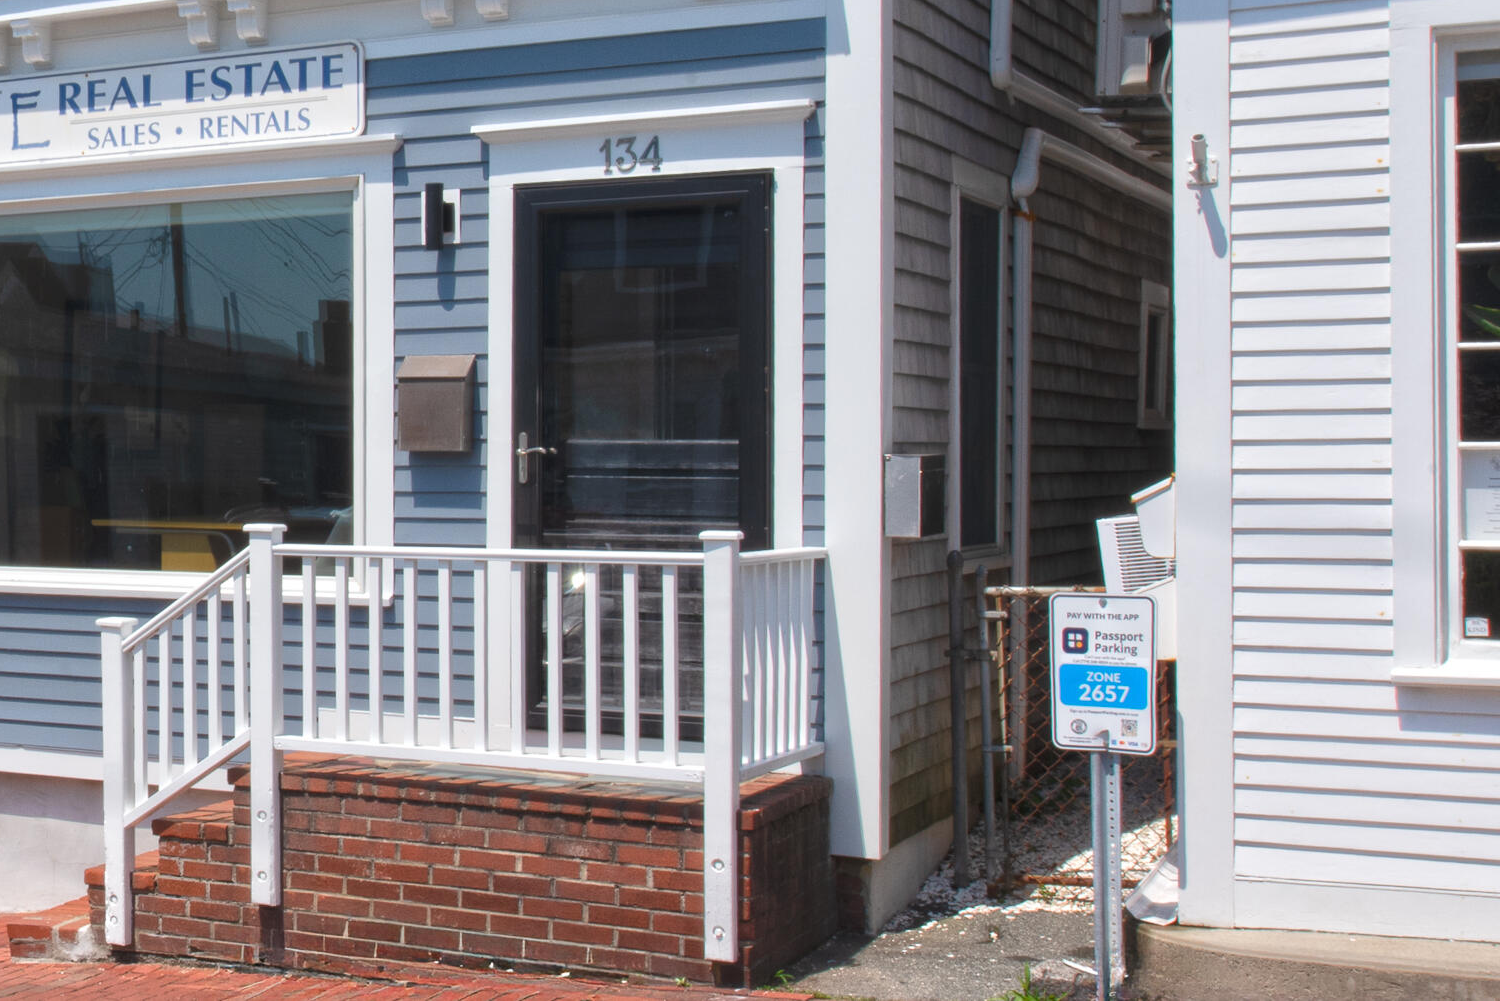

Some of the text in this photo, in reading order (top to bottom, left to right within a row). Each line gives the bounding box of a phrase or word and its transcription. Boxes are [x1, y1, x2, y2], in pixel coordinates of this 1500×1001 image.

[58, 74, 162, 115] REAL
[185, 54, 344, 103] ESTATE
[88, 108, 311, 149] SALES RENTALS
[599, 135, 663, 174] 134
[1066, 612, 1082, 620] PAY
[1107, 613, 1122, 621] THE
[1094, 630, 1143, 644] Passport
[1094, 643, 1138, 656] Parking
[1086, 671, 1121, 683] ZONE
[1078, 684, 1130, 703] 2657
